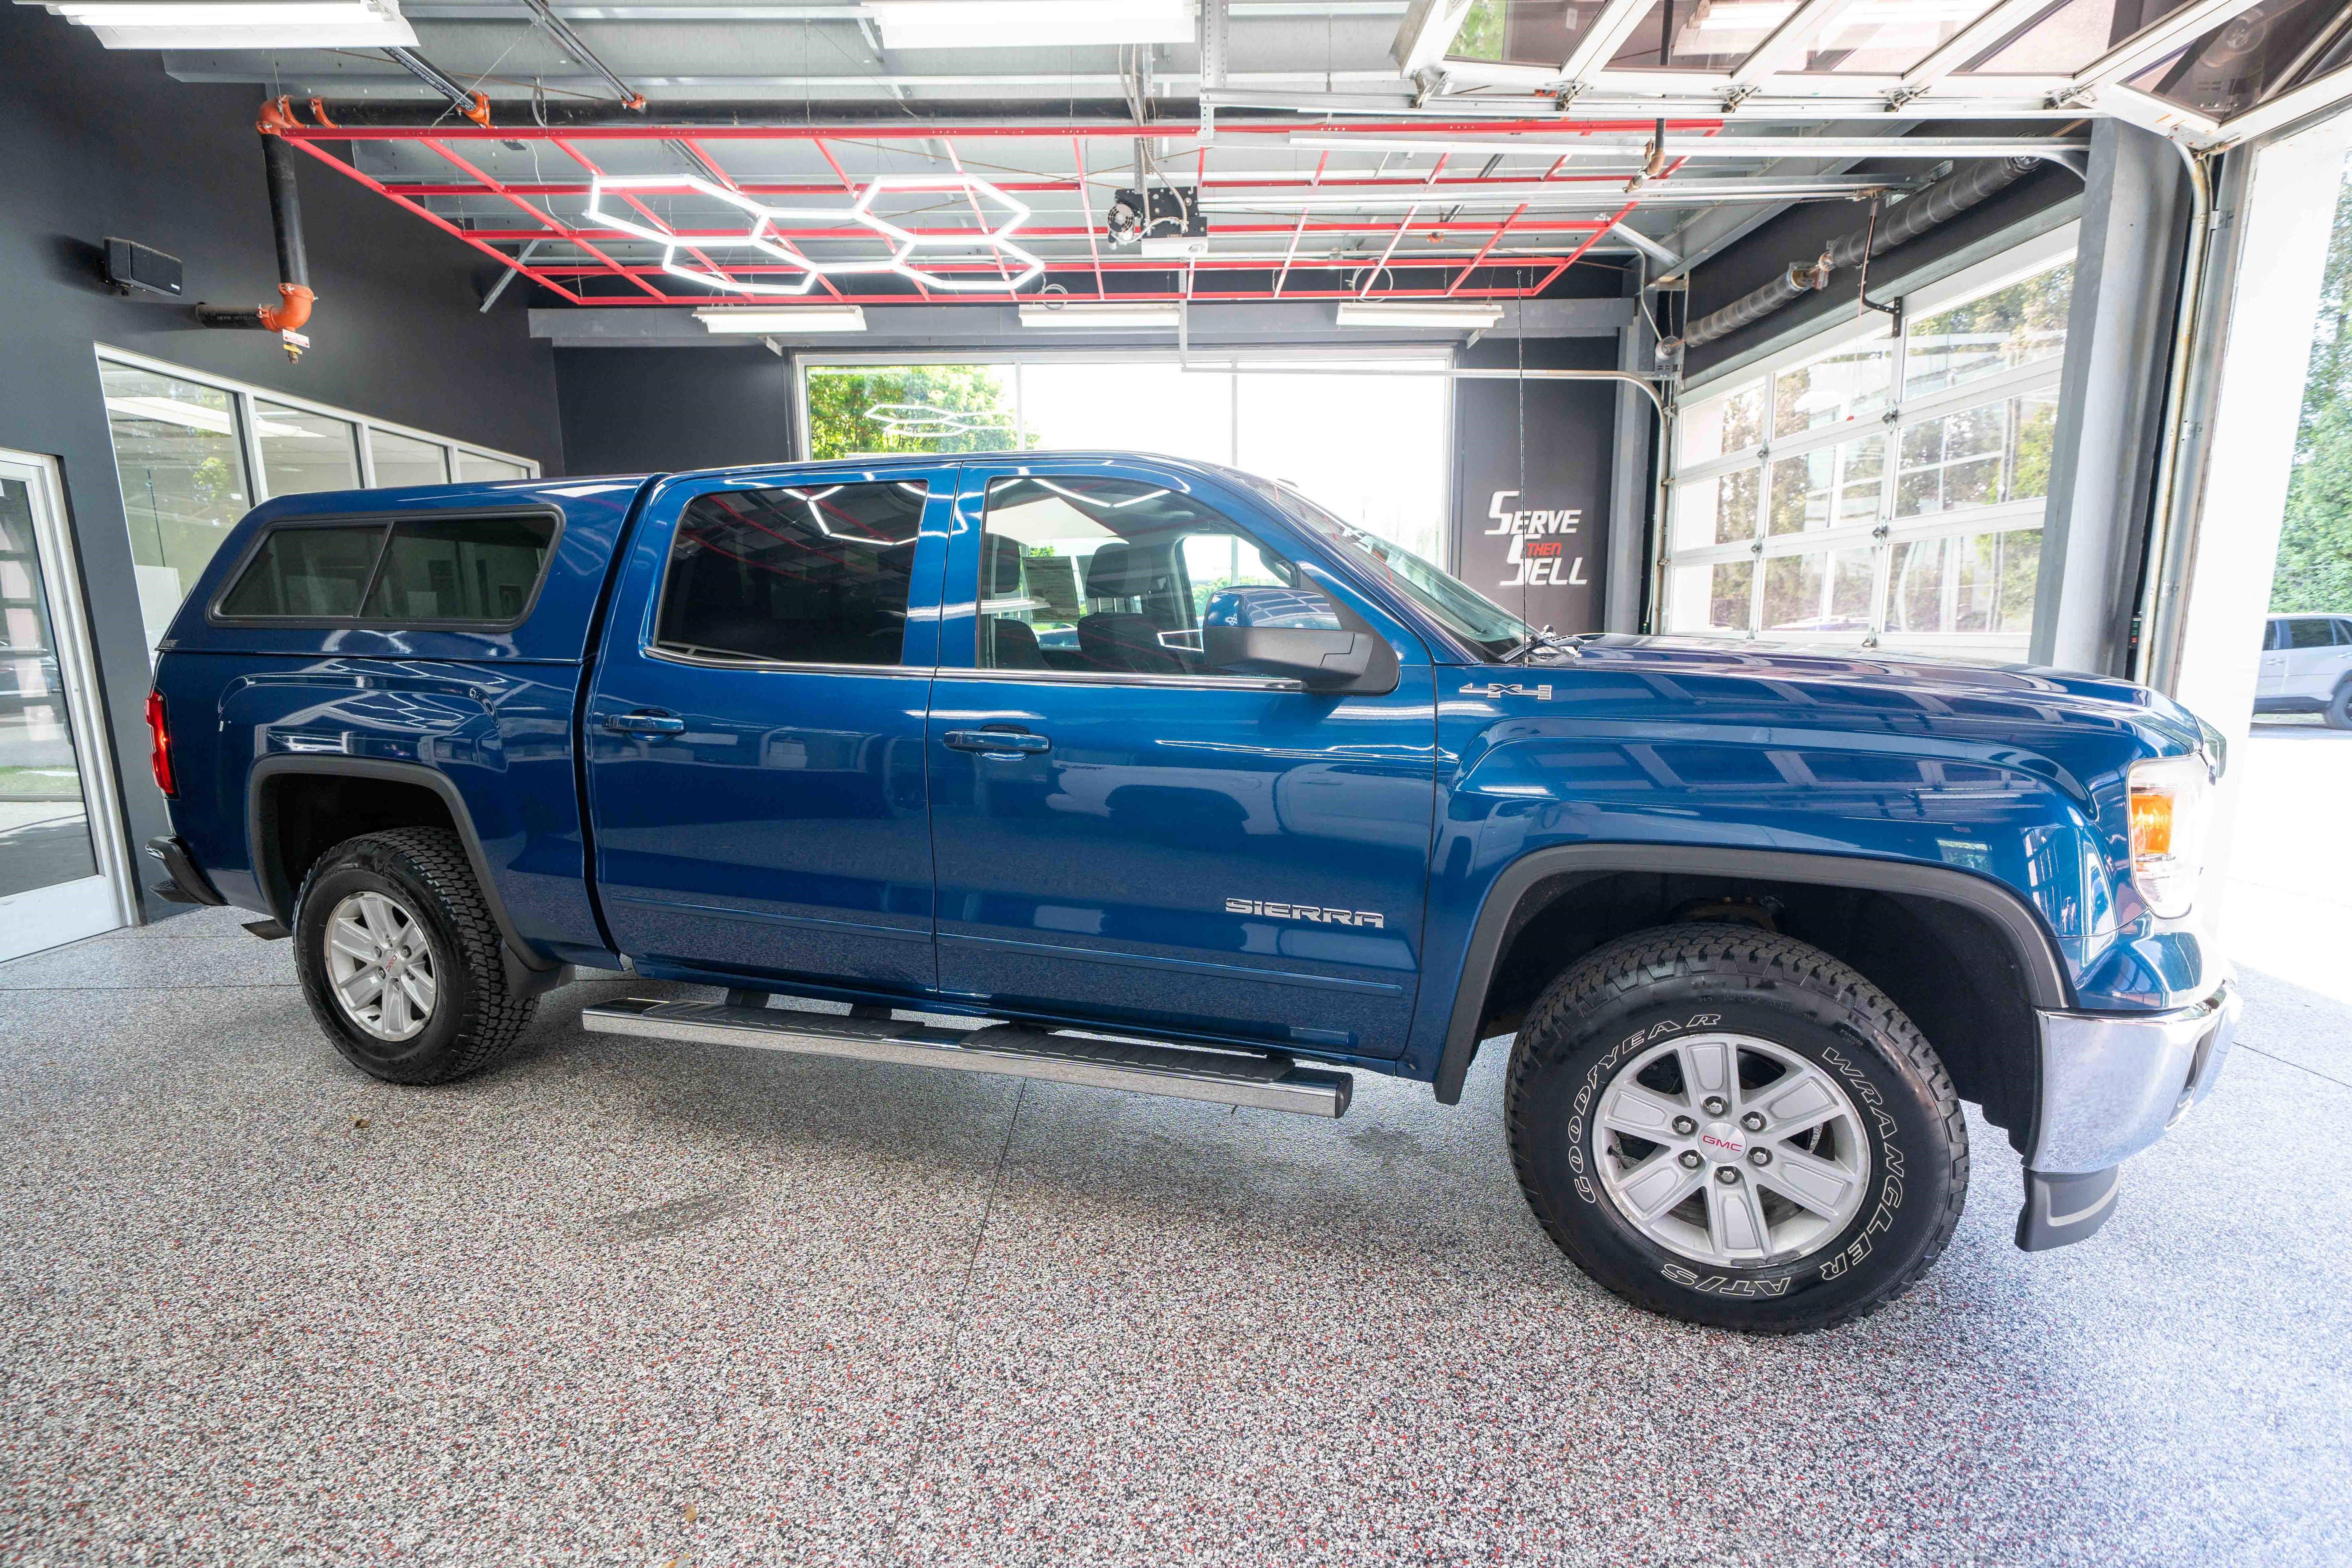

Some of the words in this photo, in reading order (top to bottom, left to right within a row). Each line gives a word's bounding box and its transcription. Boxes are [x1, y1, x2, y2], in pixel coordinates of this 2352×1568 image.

[1484, 491, 1582, 535] SERVE
[1499, 534, 1588, 586] SELL
[1225, 898, 1384, 929] SIERRA
[385, 955, 397, 972] GMC
[1568, 1014, 1721, 1203] GOODYEAR
[1703, 1135, 1743, 1152] GMC
[1820, 1047, 1904, 1280] WRANGLER
